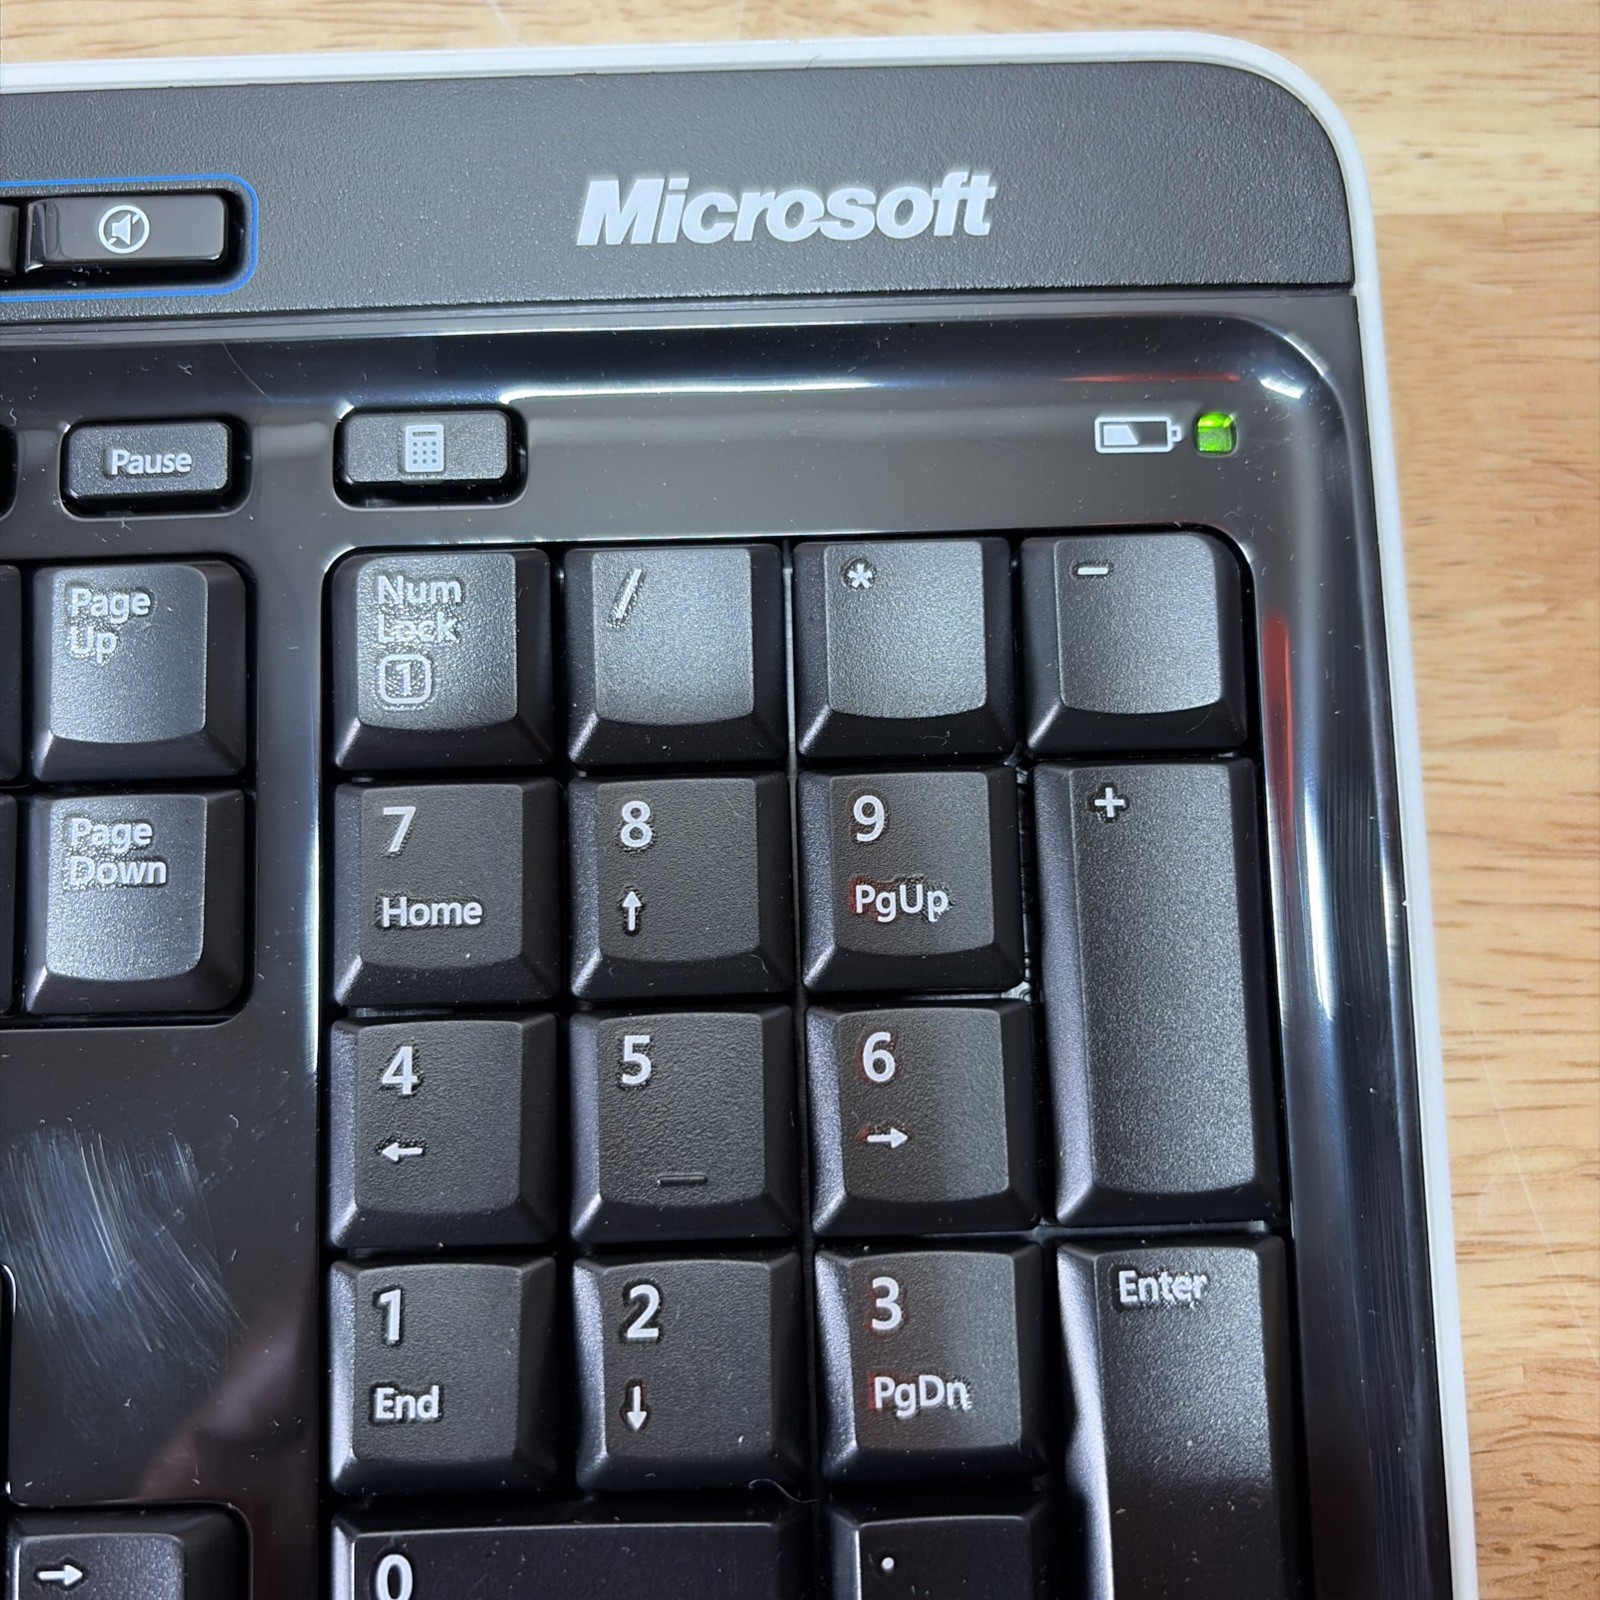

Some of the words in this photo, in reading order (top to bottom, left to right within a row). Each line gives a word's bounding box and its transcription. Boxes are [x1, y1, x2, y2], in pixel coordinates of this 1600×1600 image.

[576, 168, 997, 247] Microsoft
[110, 448, 193, 476] Pause
[69, 588, 152, 621] Page
[377, 574, 463, 606] Num
[67, 630, 118, 659] Up
[376, 611, 457, 645] Lock
[69, 818, 153, 850] Page
[381, 805, 416, 853] 7
[620, 800, 653, 849] 8
[852, 795, 885, 841] 9
[67, 857, 168, 884] Down
[380, 897, 483, 928] Home
[855, 881, 950, 924] PgUp
[380, 1046, 419, 1097] 4
[621, 1034, 652, 1085] 5
[862, 1031, 896, 1083] 6
[870, 1276, 903, 1331] 3
[1117, 1269, 1209, 1305] Enter
[374, 1289, 401, 1343] 1
[625, 1284, 660, 1340] 2
[373, 1384, 441, 1421] End
[873, 1375, 973, 1419] PgDn
[376, 1554, 413, 1600] 0
